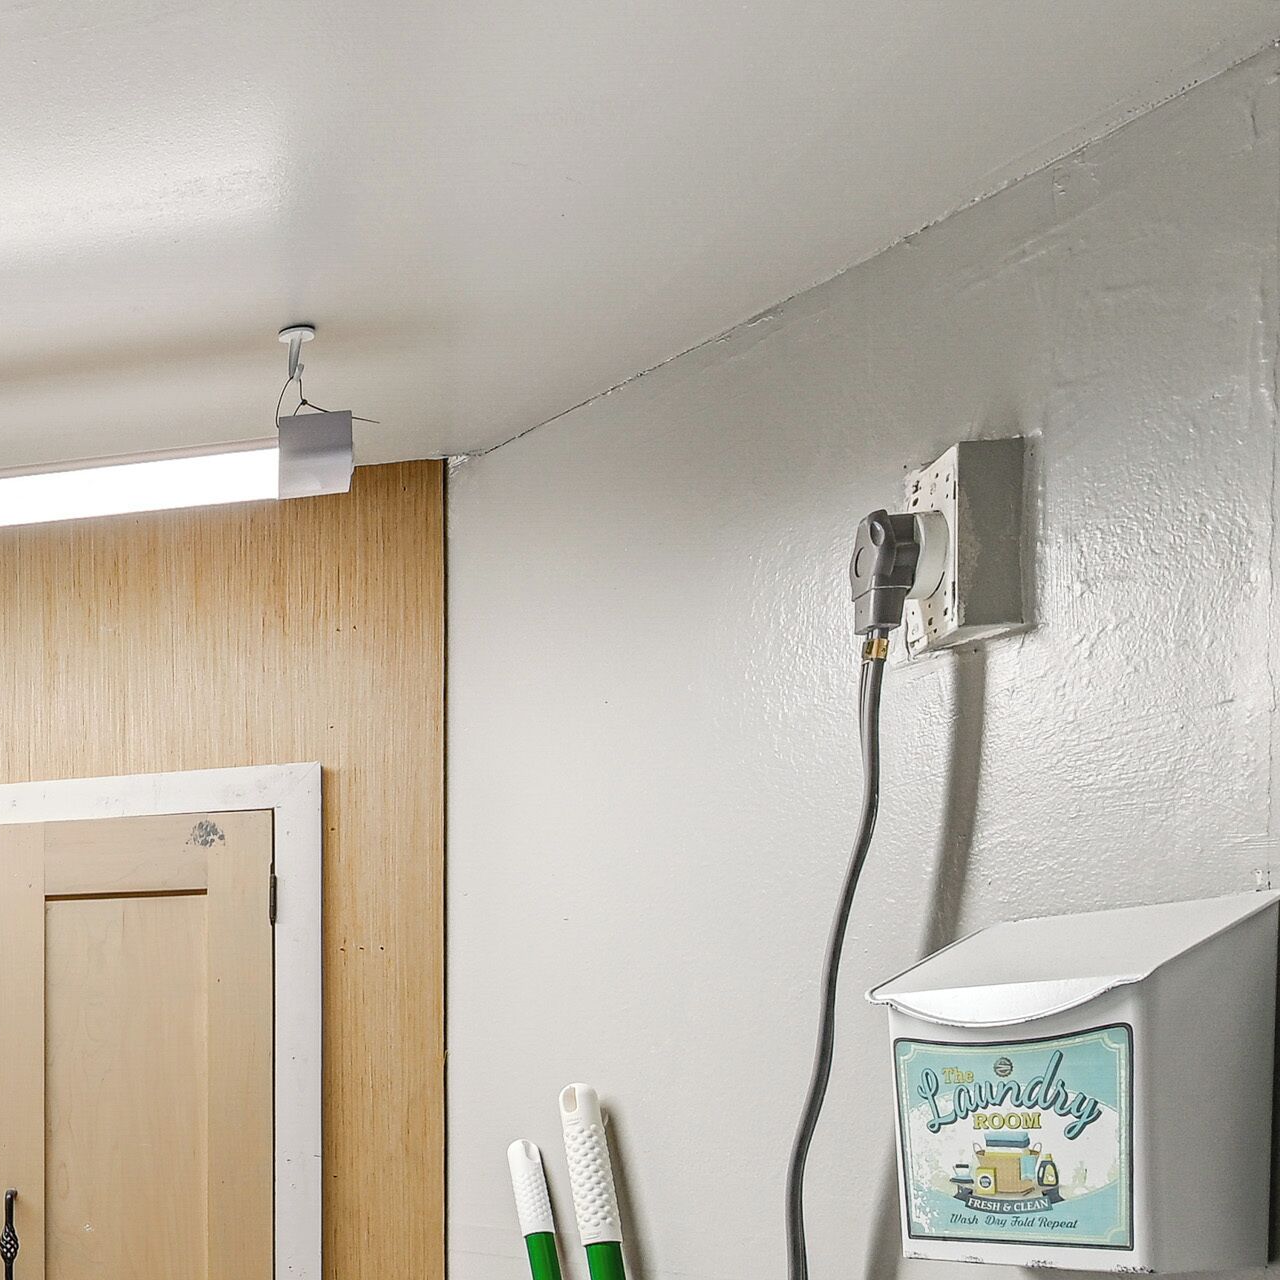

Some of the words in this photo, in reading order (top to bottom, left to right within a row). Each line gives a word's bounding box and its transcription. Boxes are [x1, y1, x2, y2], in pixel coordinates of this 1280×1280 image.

[942, 1066, 975, 1084] The
[917, 1050, 1102, 1140] Laundry
[972, 1112, 1042, 1130] ROOM
[967, 1198, 1000, 1211] FRESH
[1002, 1203, 1012, 1212] &
[1013, 1198, 1049, 1211] CLEAN
[949, 1213, 979, 1225] Wash
[985, 1215, 1007, 1227] Dry
[1010, 1216, 1034, 1228] Fold
[1038, 1217, 1079, 1230] Repeat
